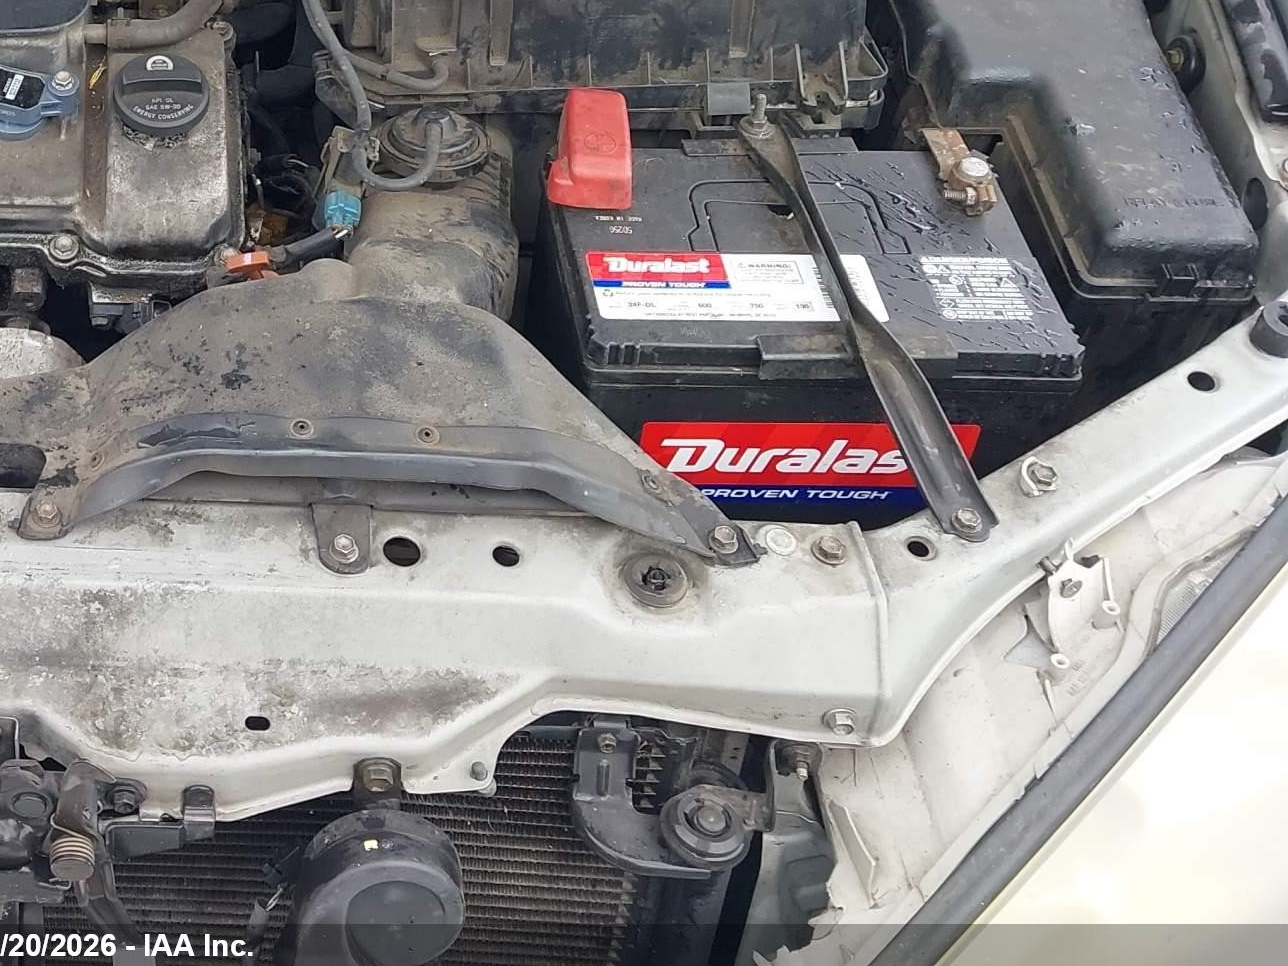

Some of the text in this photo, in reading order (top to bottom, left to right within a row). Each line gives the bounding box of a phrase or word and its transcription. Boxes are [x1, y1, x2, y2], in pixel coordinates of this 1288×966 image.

[603, 256, 710, 274] Duralast
[661, 438, 909, 474] Duralas
[807, 489, 889, 500] TOUGH
